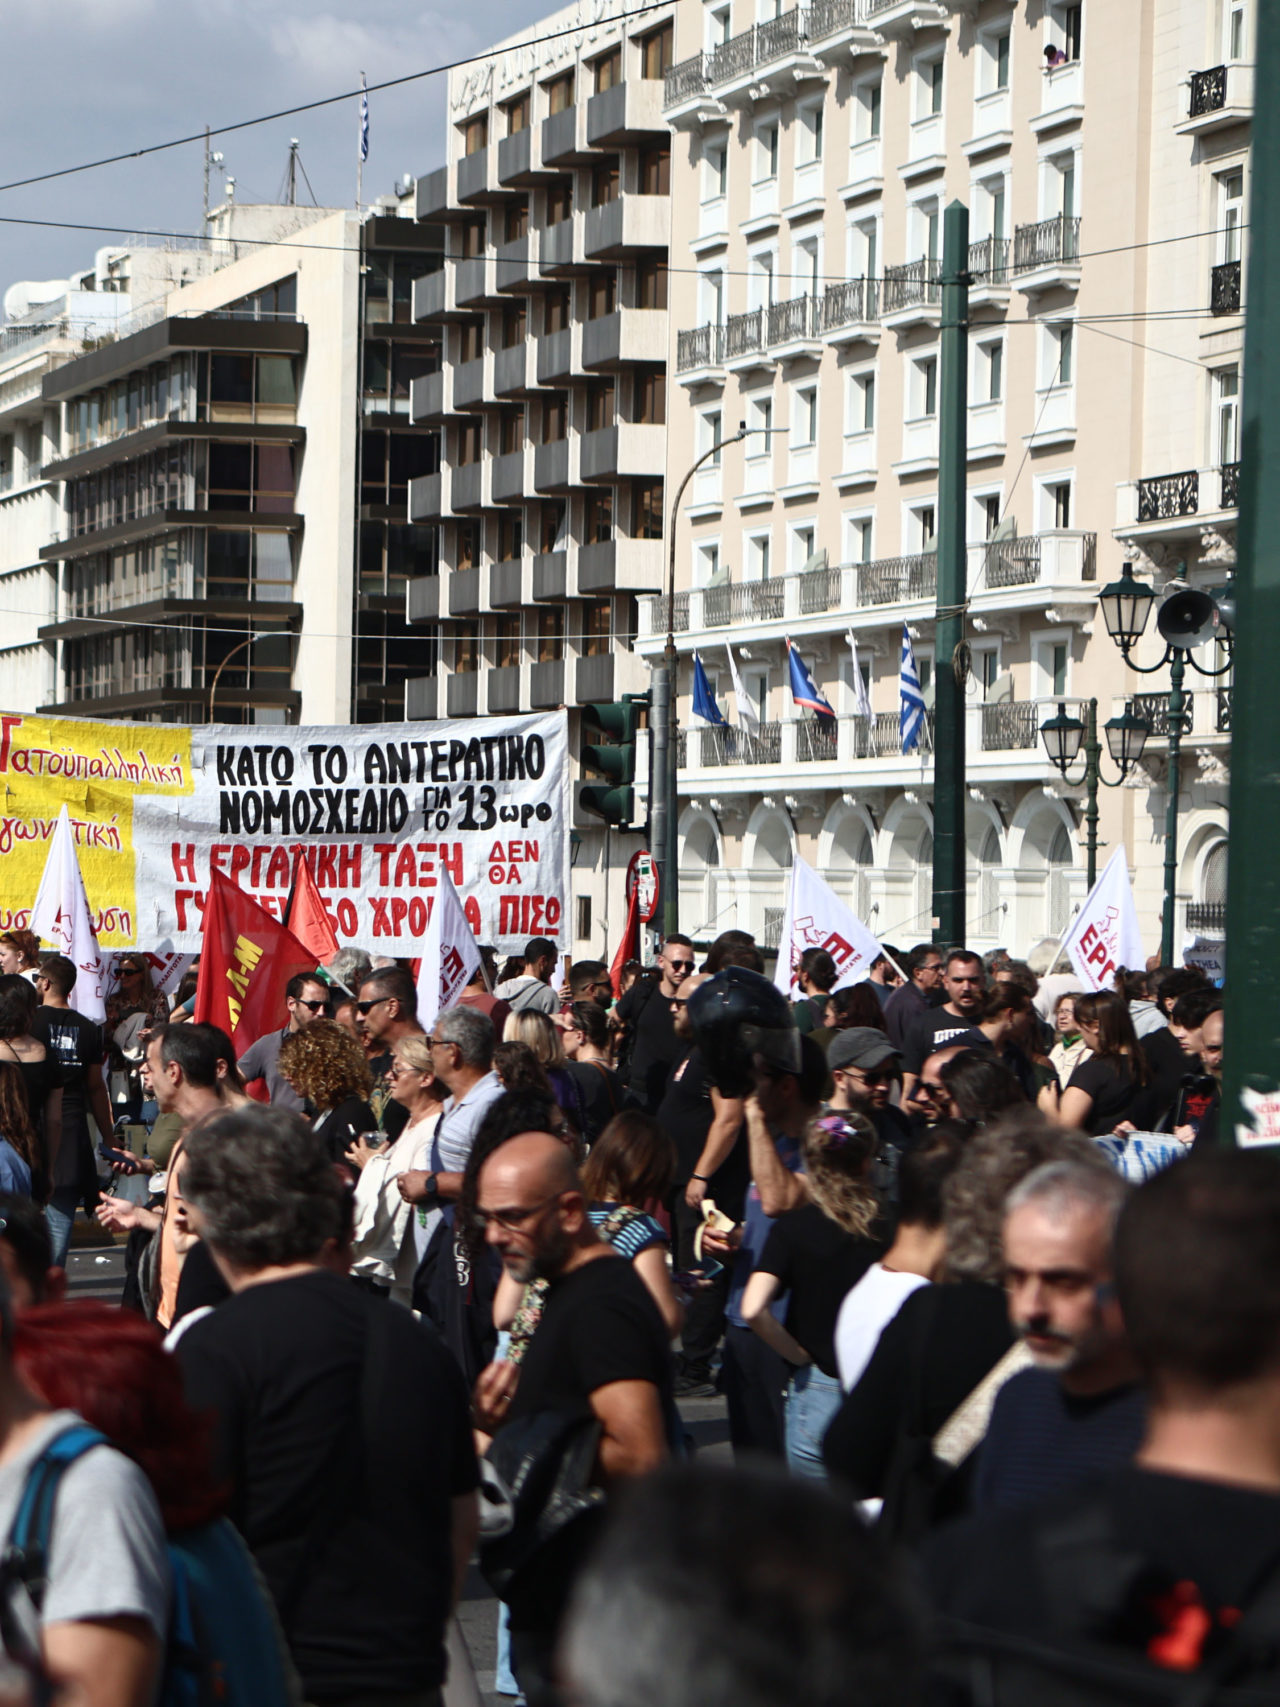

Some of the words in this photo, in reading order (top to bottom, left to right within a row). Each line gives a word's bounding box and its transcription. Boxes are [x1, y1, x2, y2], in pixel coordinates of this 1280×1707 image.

[217, 745, 294, 786] ΚΑΤΩ
[308, 745, 347, 785] ΤΟ
[364, 734, 545, 784] ΑΝΤΕΡΑΤΙΚΟ
[220, 787, 409, 834] ΝΟΜΟΣΧΕΔΙΟ
[423, 786, 452, 809] ΓΙΑ
[423, 809, 450, 831] ΤΟ
[172, 843, 197, 883] Η
[373, 842, 464, 887] ΤΑΞΗ
[489, 840, 539, 862] ΔΕΝ
[489, 864, 522, 884] ΘΑ
[499, 895, 561, 935] ΠΙΣΩ
